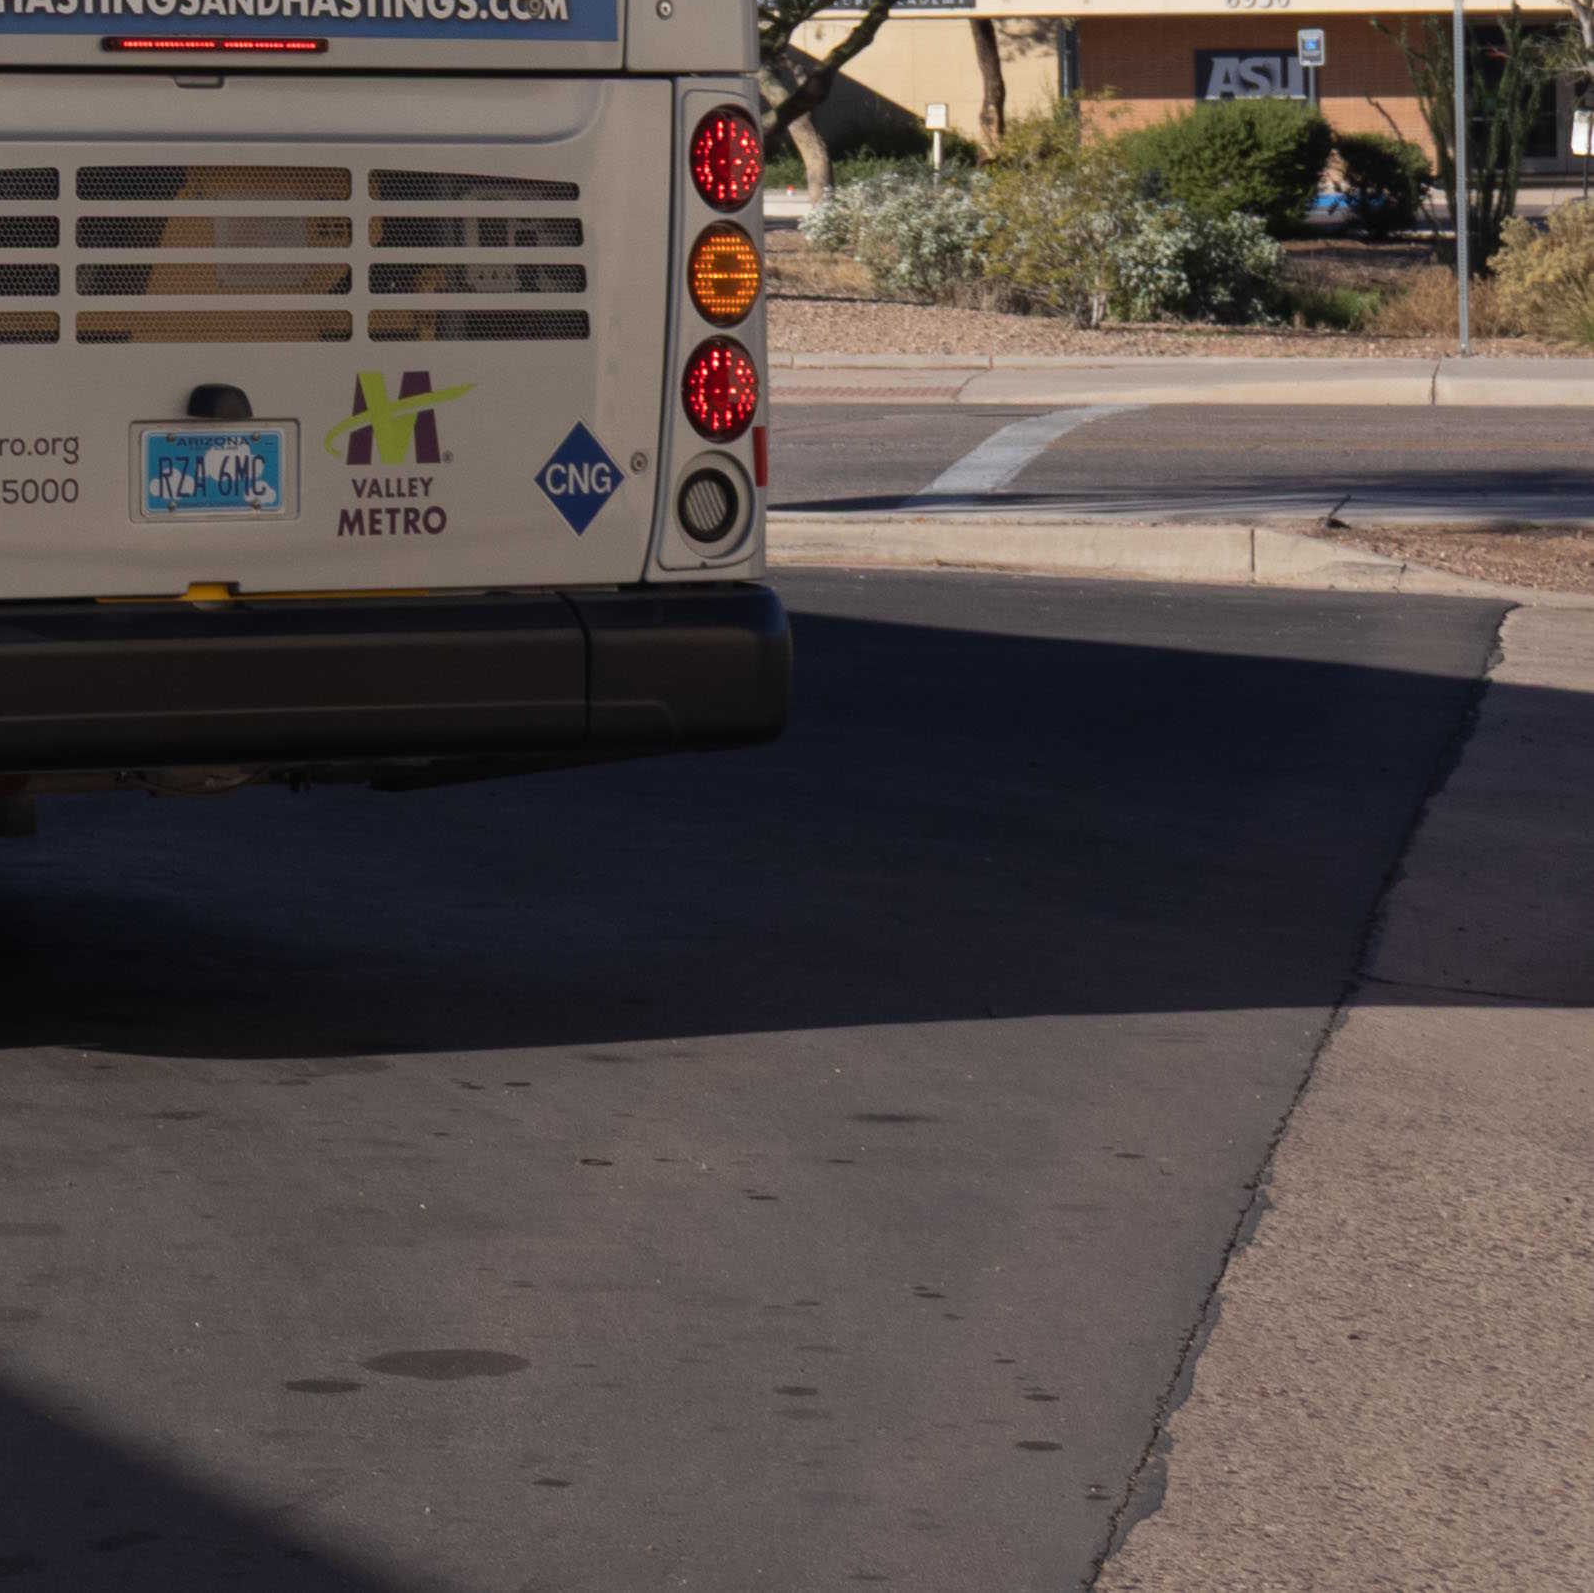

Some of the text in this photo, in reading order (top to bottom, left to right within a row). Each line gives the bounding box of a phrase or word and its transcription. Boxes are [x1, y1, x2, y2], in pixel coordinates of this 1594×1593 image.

[1205, 56, 1308, 100] ASU
[176, 435, 251, 448] ARIZONA
[351, 476, 434, 499] VALLEY
[545, 462, 612, 496] CNG
[336, 505, 448, 537] METRO
